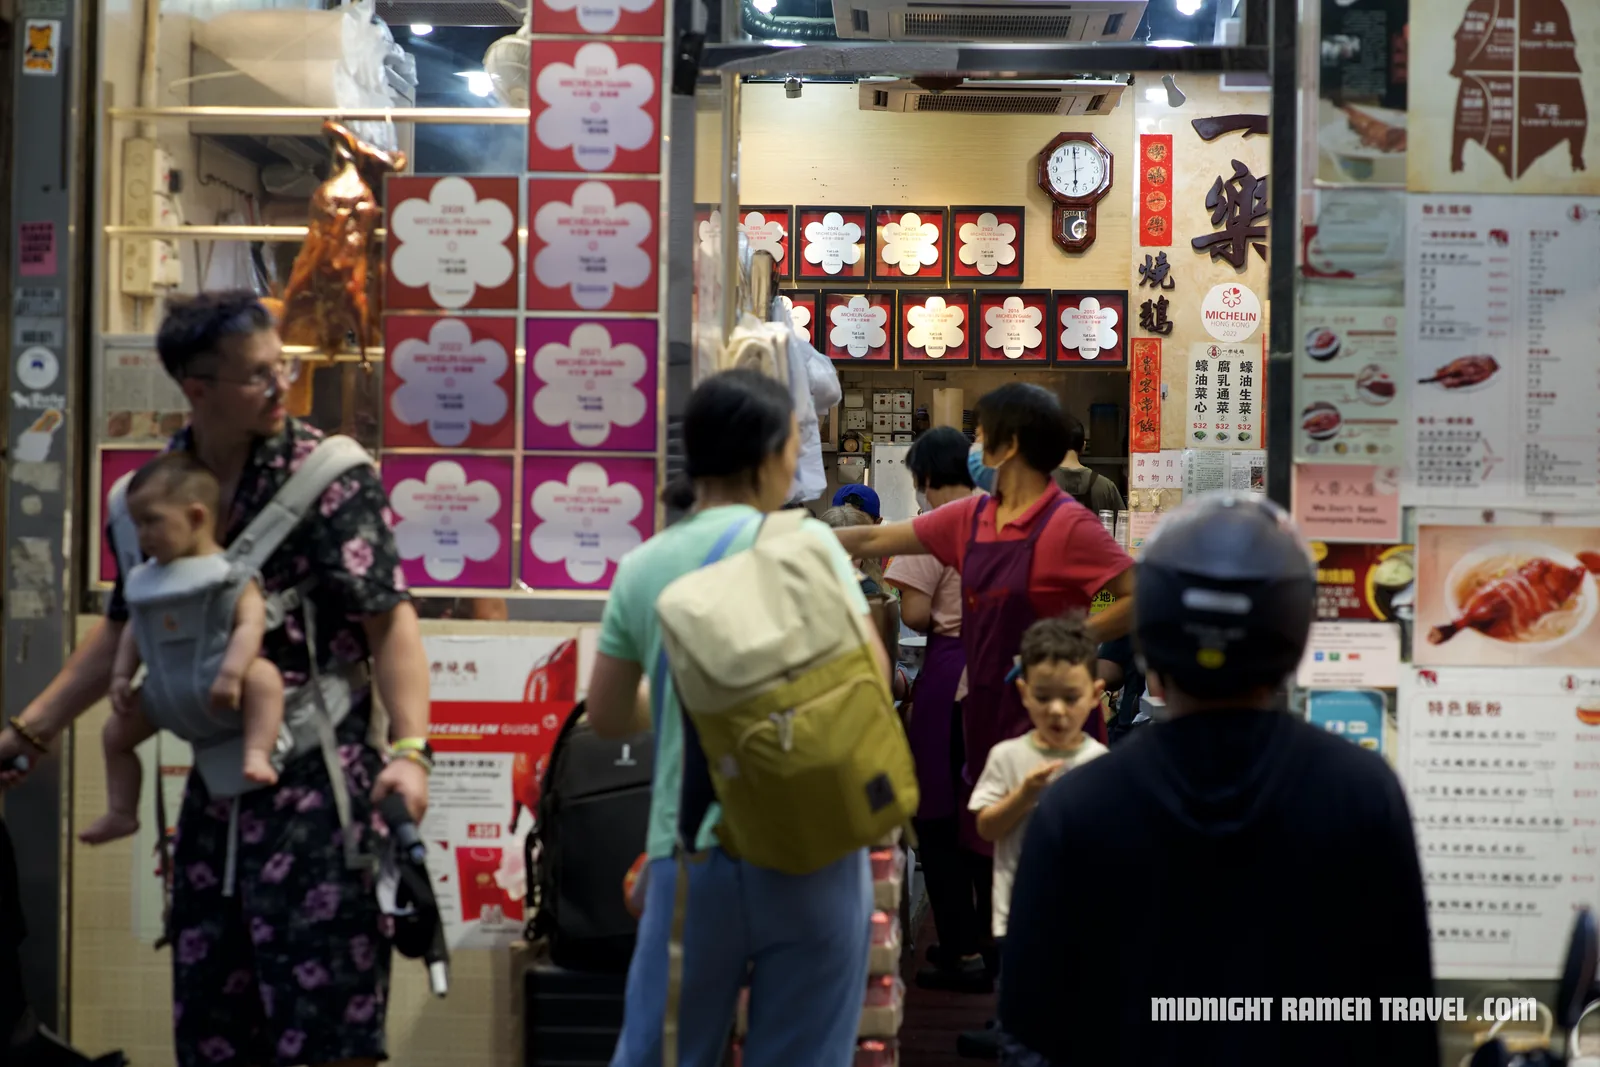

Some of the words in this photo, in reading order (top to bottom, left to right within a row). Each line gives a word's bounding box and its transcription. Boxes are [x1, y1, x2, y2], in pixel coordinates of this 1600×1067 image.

[1138, 251, 1176, 335] 燒鵝
[1205, 311, 1257, 322] MICHELIN
[1194, 359, 1209, 413] 蠔油菜心
[1216, 360, 1231, 414] 腐乳通菜
[1238, 361, 1253, 415] 蠔油生菜
[1137, 459, 1182, 468] 請勿自
[1137, 474, 1182, 482] 食物內
[500, 724, 539, 736] GUIDE
